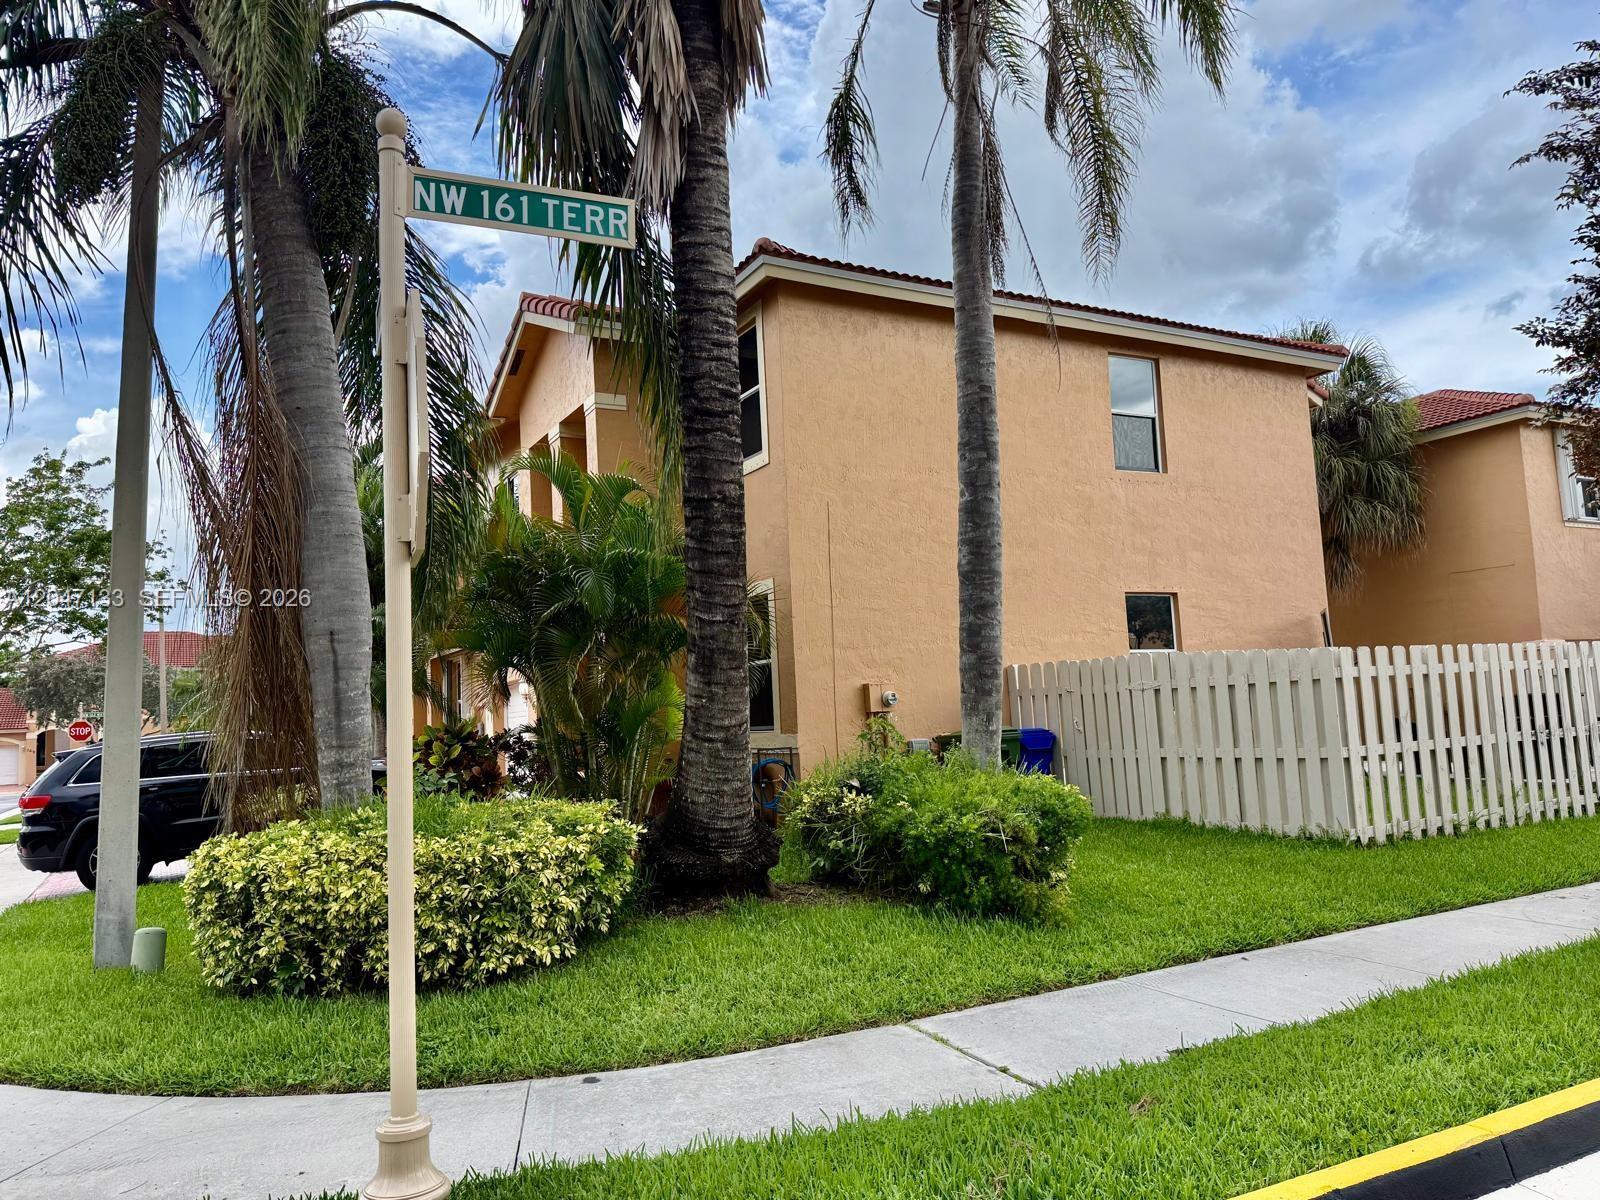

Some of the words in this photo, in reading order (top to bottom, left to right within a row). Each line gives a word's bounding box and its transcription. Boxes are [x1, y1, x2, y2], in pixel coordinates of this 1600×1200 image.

[414, 180, 467, 215] NW
[480, 190, 529, 224] 161
[541, 198, 628, 239] TERR
[70, 727, 91, 736] STOP
